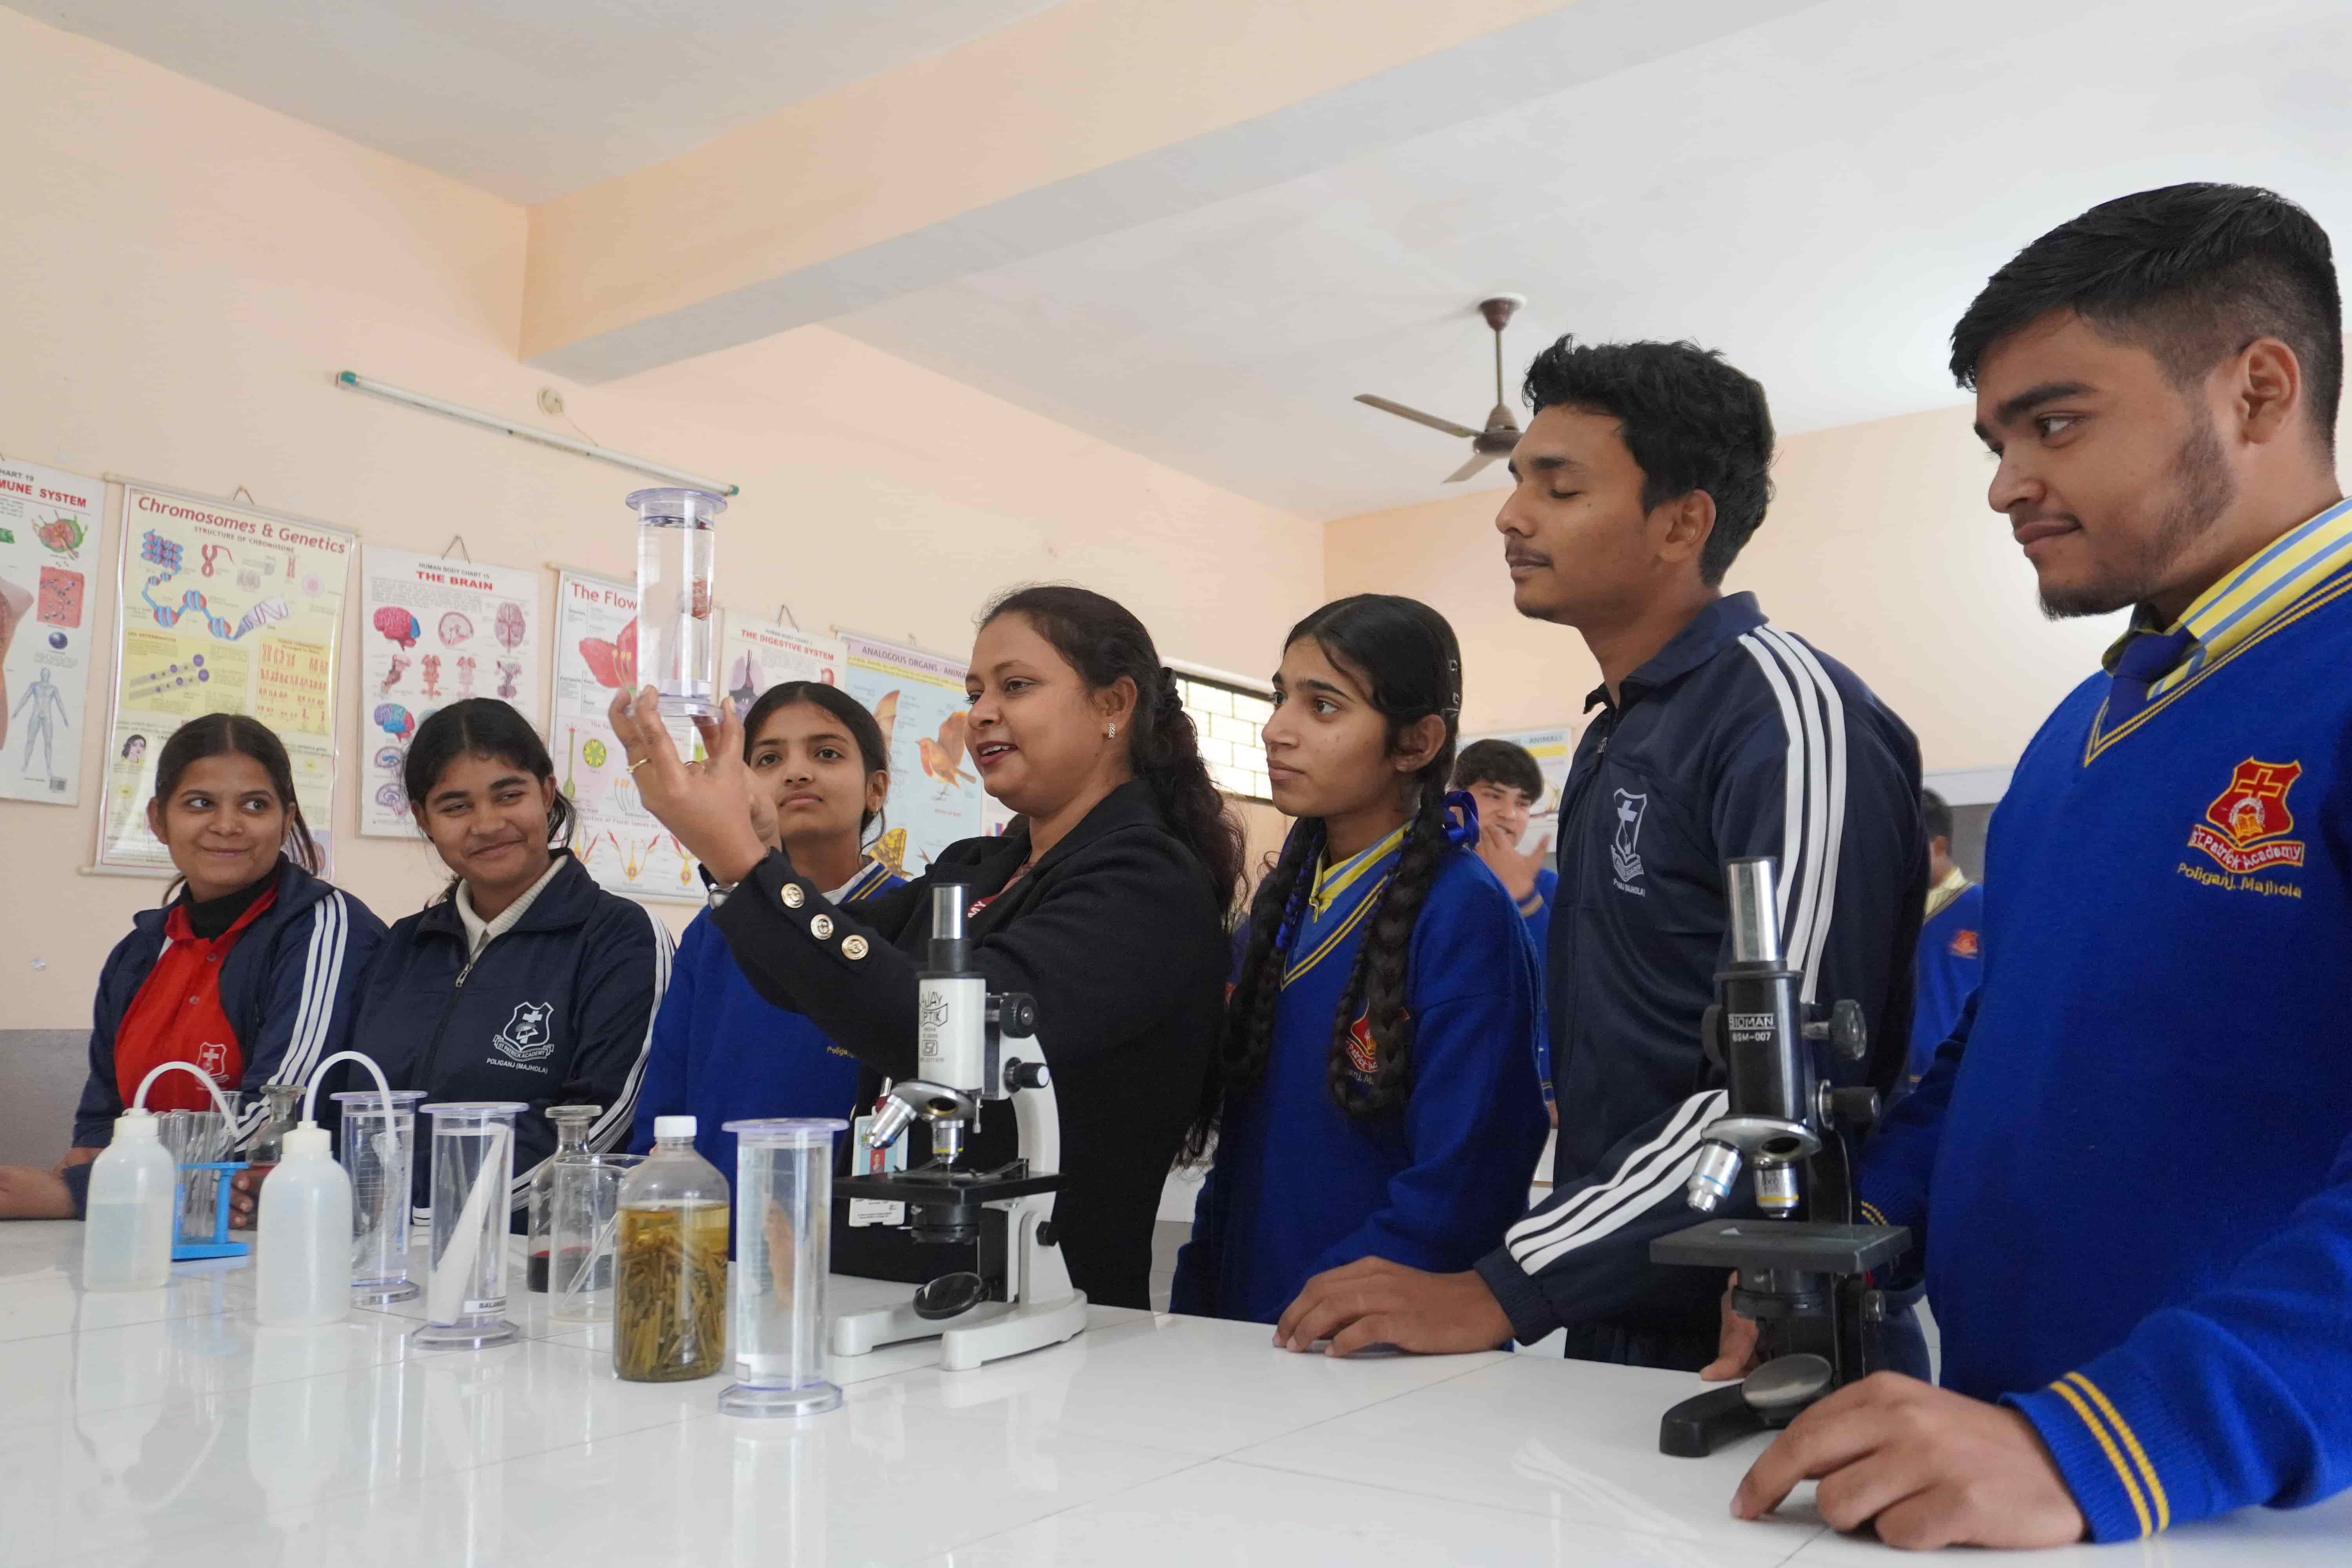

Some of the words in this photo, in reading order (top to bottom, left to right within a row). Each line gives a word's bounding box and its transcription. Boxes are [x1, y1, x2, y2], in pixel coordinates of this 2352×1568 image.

[40, 488, 87, 508] SYSTEM
[138, 496, 256, 534] Chromosomes
[262, 524, 273, 537] &
[279, 528, 345, 554] Genetics
[194, 527, 234, 540] STRUCTURE
[249, 539, 295, 552] CHROMOSOME
[419, 563, 441, 571] HUMAN
[416, 570, 445, 583] THE
[450, 576, 493, 591] BRAIN
[571, 583, 599, 602] The
[741, 629, 757, 640] THE
[760, 635, 801, 652] DIGESTIVE
[804, 646, 834, 661] SYSTEM
[862, 646, 906, 664] ANALOGOUS
[909, 658, 938, 672] ORGANS
[1529, 735, 1563, 744] ANIMALS
[2240, 877, 2301, 898] Majhola
[504, 1045, 521, 1058] PATRICK
[486, 1058, 515, 1068] POLIGANJ
[516, 1063, 548, 1074] (MAJHOLA)
